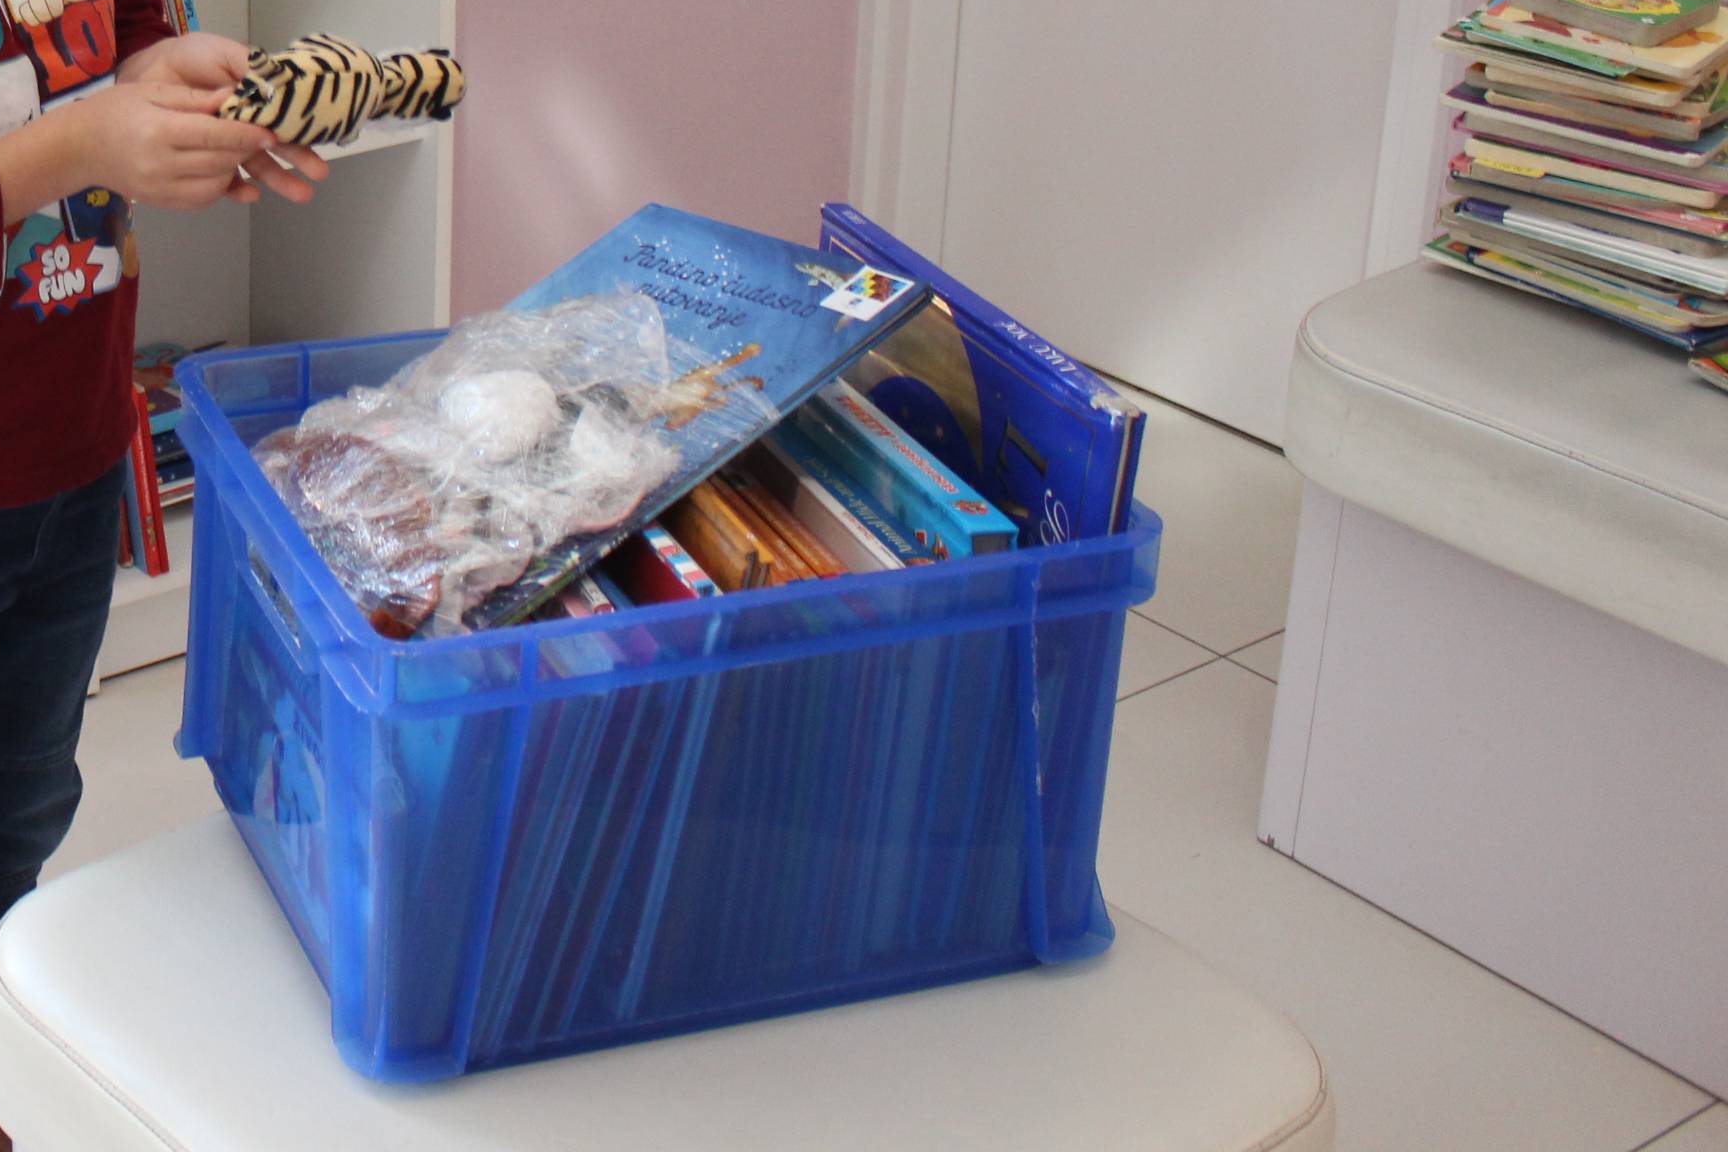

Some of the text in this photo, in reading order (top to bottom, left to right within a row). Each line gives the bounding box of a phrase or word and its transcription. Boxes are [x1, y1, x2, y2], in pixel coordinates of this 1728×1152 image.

[15, 0, 116, 95] LO
[38, 267, 86, 304] FUN
[41, 244, 70, 277] SO
[624, 242, 818, 319] Pandino čudesno
